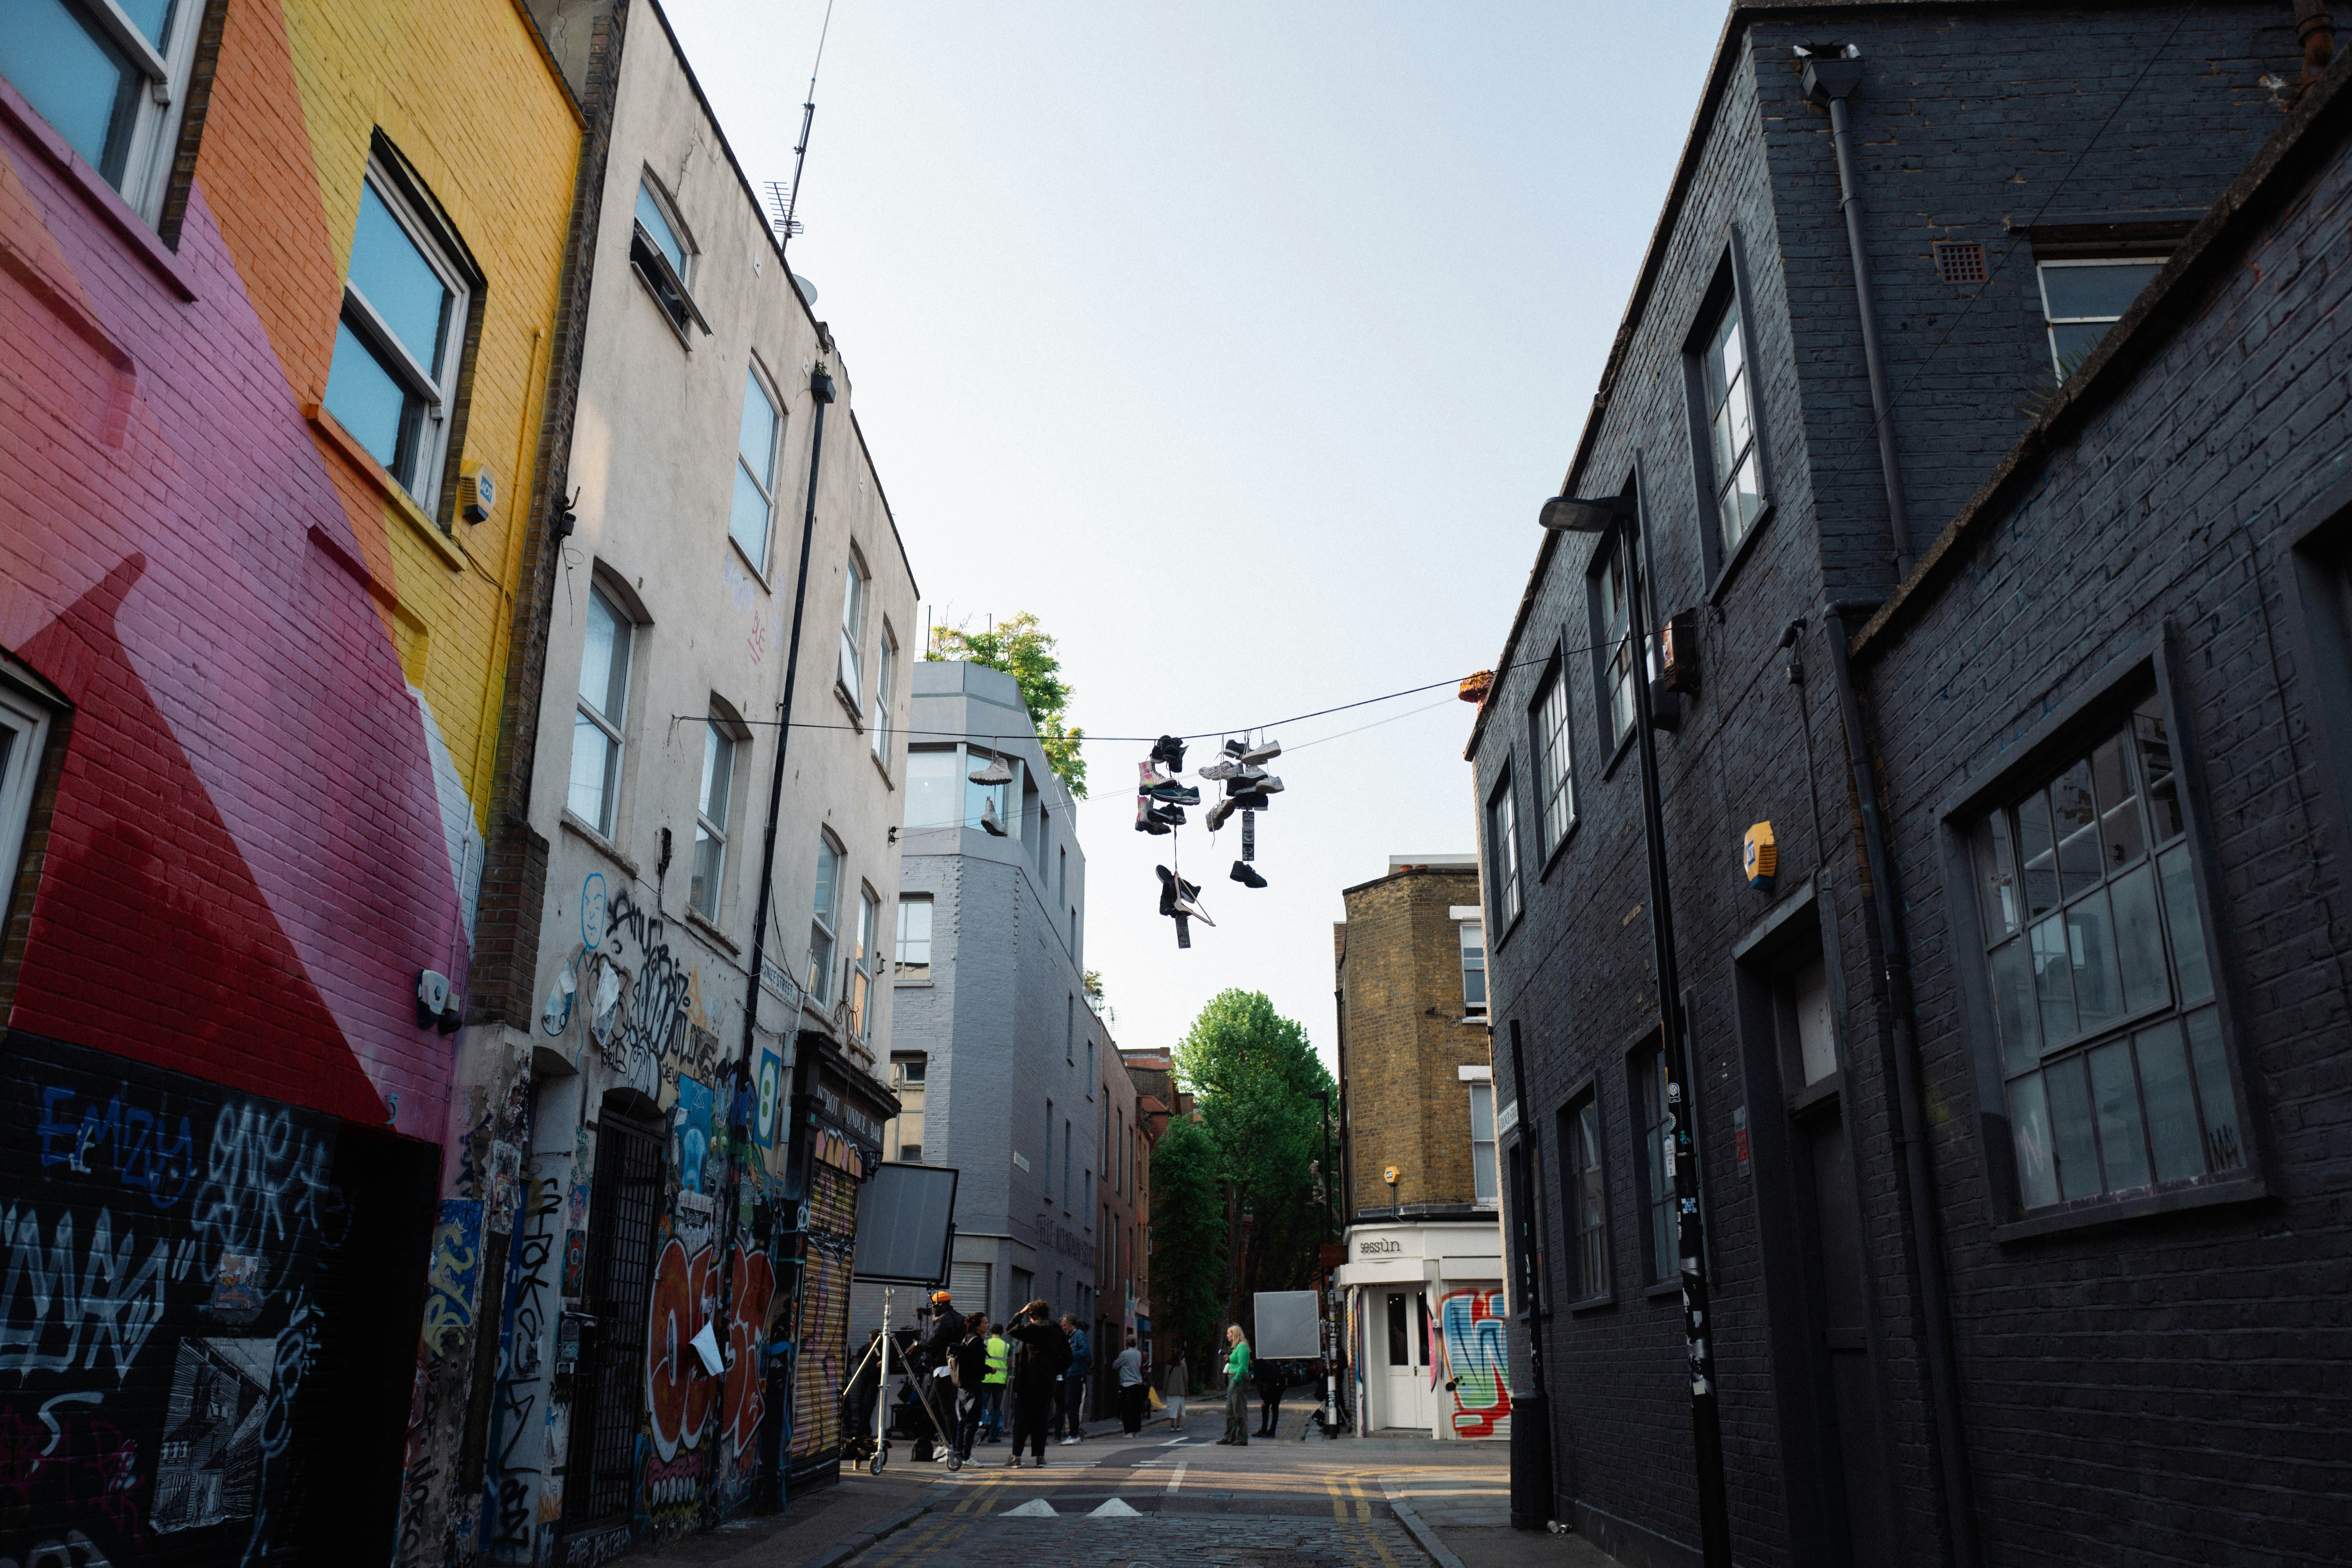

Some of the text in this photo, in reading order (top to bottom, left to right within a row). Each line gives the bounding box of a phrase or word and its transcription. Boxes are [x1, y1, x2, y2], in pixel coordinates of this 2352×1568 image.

[760, 962, 793, 998] HANCE STREET
[817, 1085, 840, 1116] ISTROT
[870, 1121, 881, 1144] BAR
[1360, 1238, 1401, 1253] sessùn
